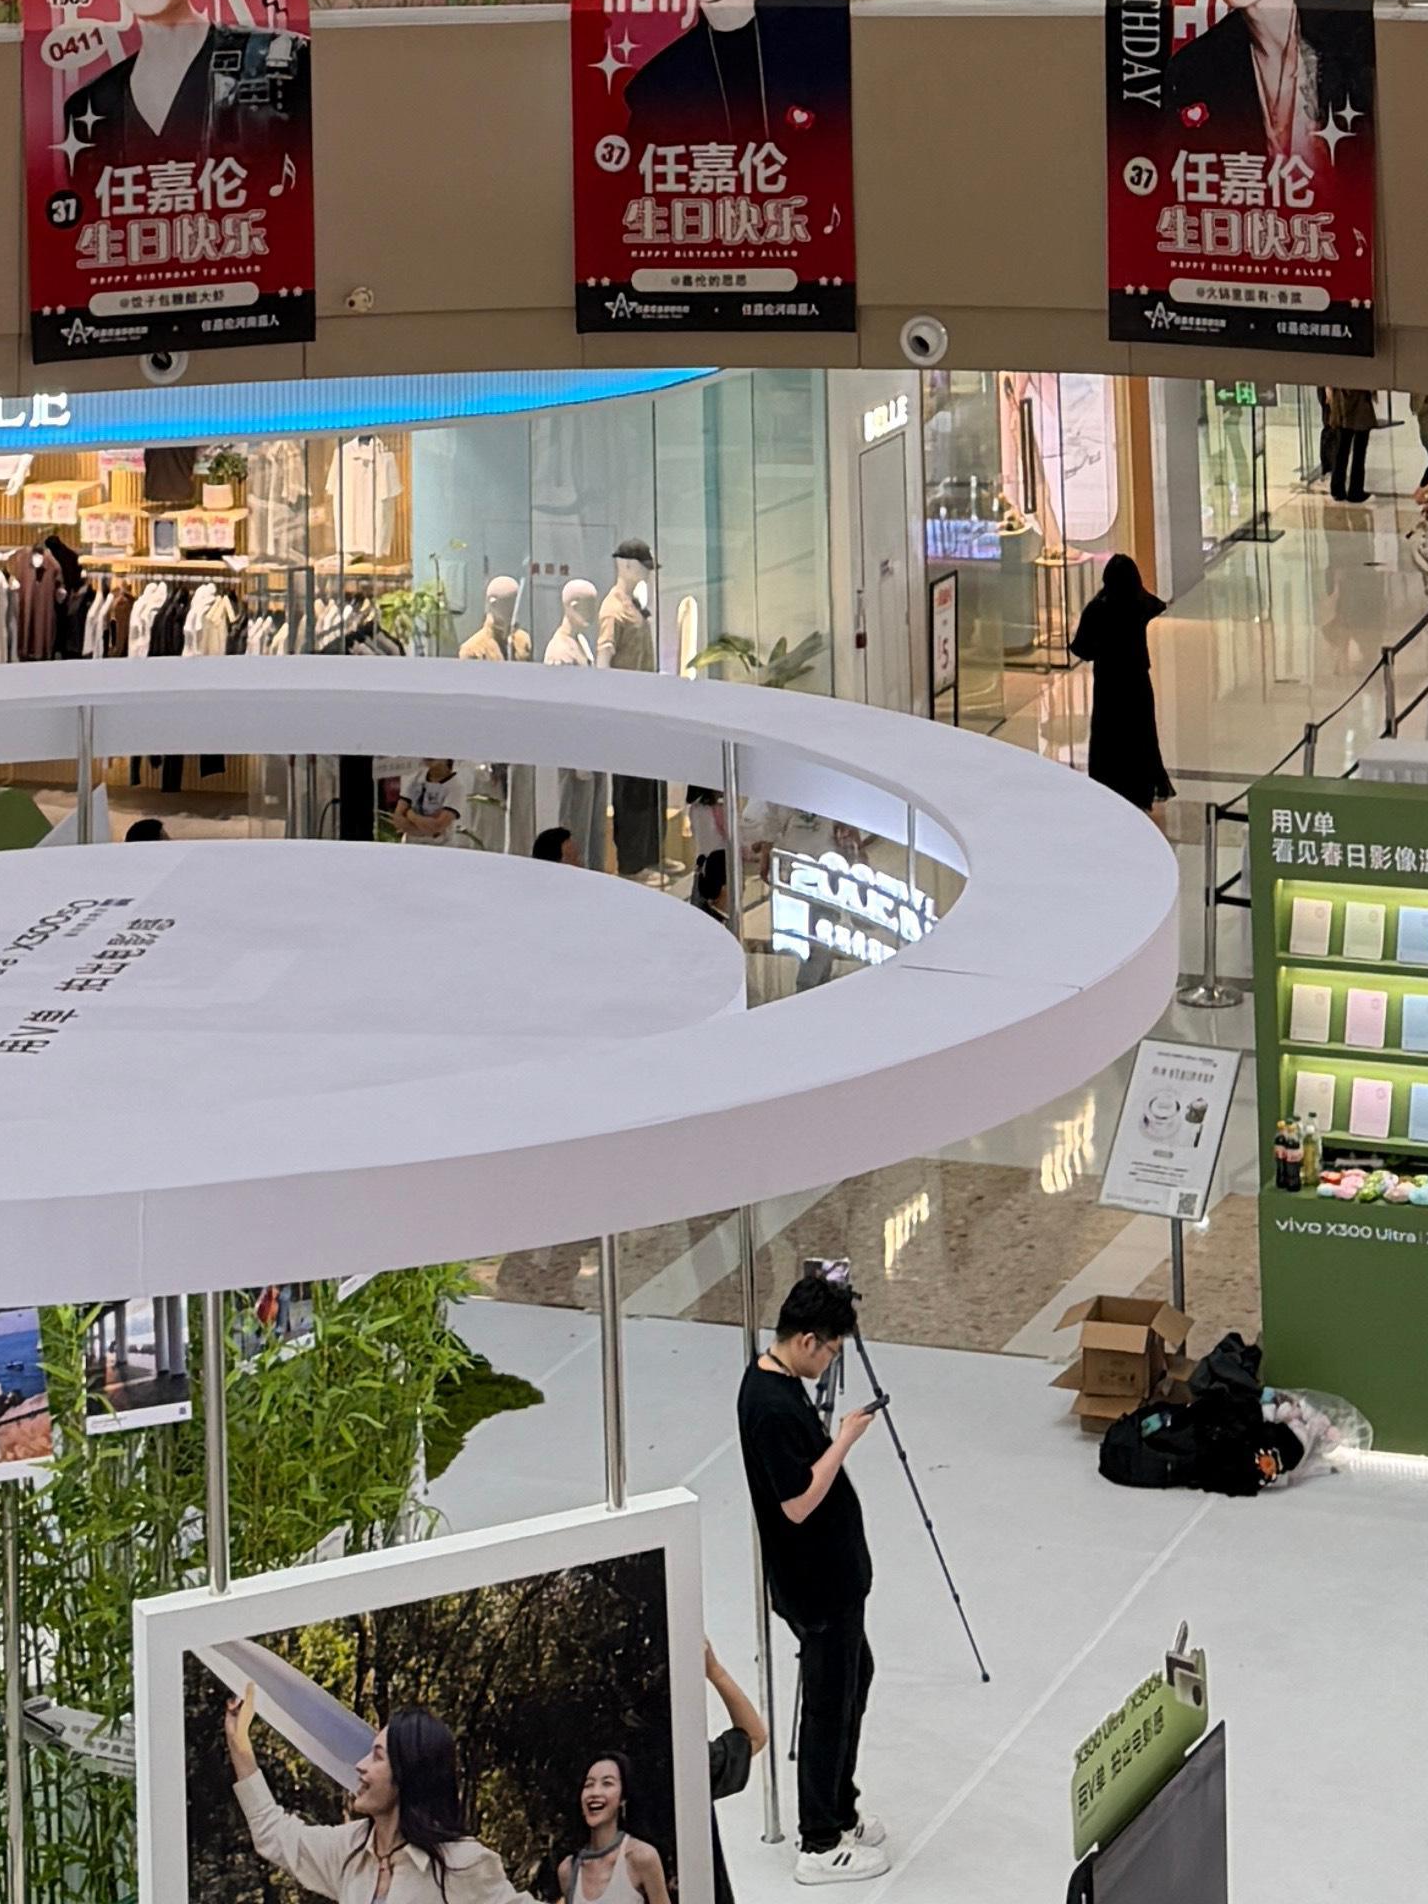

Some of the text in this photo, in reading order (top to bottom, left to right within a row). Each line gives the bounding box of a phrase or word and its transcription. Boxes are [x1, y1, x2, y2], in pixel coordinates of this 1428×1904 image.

[51, 30, 104, 61] 0411
[601, 143, 626, 163] 37
[639, 142, 787, 194] 任嘉伦
[95, 157, 247, 219] 任嘉伦
[1130, 167, 1153, 187] 37
[1171, 149, 1315, 207] 任嘉伦
[52, 200, 77, 221] 37
[624, 195, 810, 245] 生日快乐
[75, 210, 269, 269] 生日快乐
[1157, 205, 1338, 261] 生日快乐
[1272, 809, 1335, 837] 用V单
[1276, 1218, 1321, 1233] vivo
[1325, 1223, 1371, 1239] X300
[1376, 1227, 1416, 1243] Ultra
